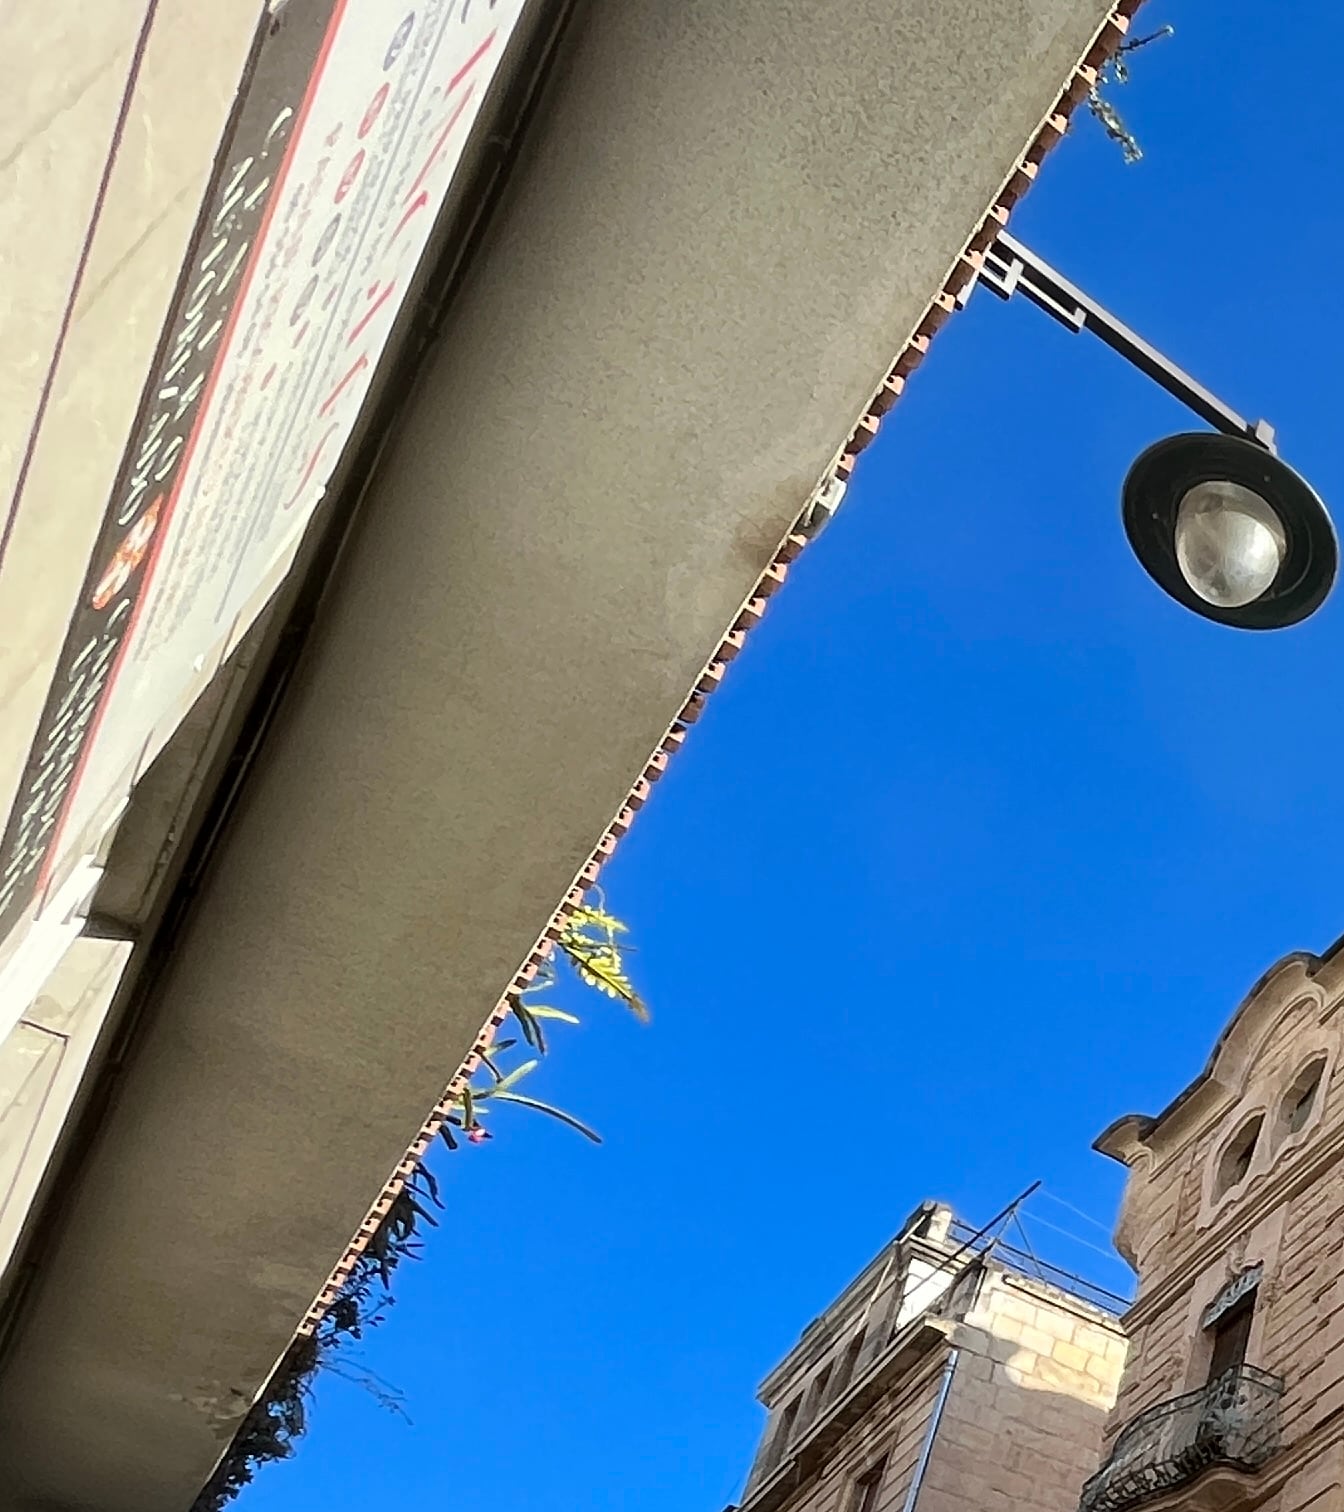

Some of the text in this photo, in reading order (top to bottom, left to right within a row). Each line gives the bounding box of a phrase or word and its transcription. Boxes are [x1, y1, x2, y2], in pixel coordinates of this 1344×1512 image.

[118, 156, 255, 527] AUTORIZADO
[155, 107, 292, 482] CENTRO
[24, 599, 130, 875] CAMBRIDGE
